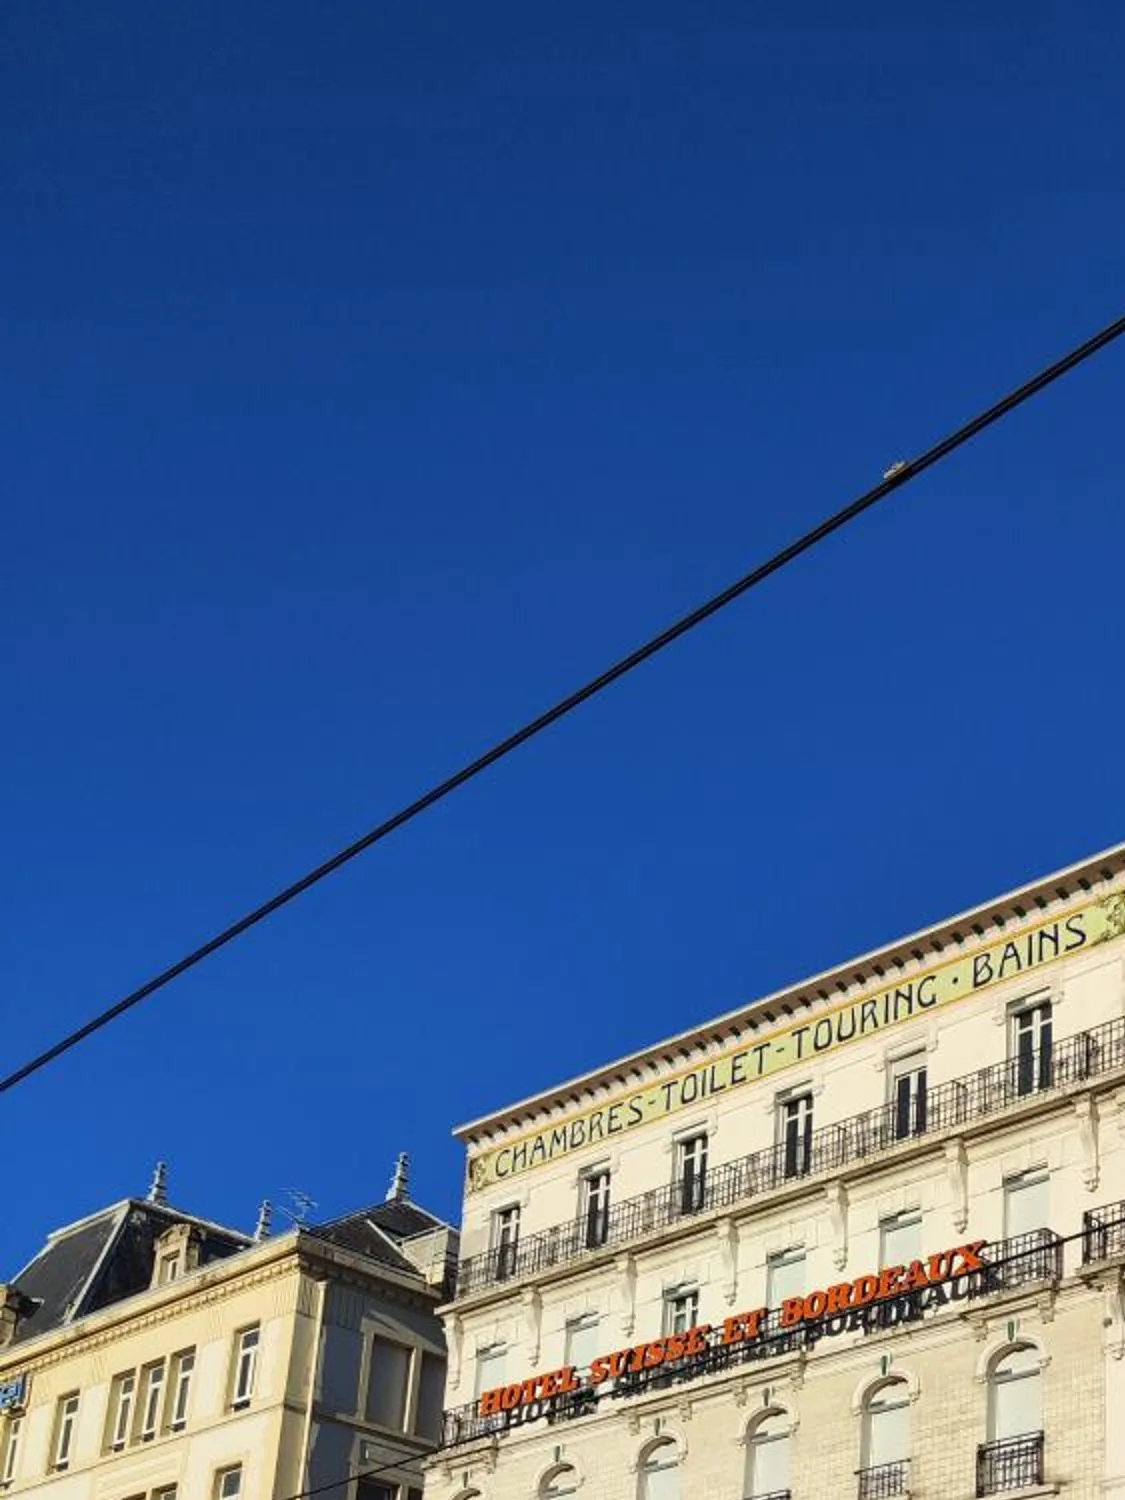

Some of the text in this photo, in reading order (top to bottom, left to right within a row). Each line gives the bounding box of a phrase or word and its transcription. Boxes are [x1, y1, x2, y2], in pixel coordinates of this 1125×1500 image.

[494, 1102, 644, 1178] CHAMBRES
[661, 1042, 771, 1112] TOILET
[791, 974, 938, 1060] TOURING
[971, 913, 1088, 989] BAINS
[480, 1239, 987, 1418] HOTEL SUISSE ET BORDEAUX
